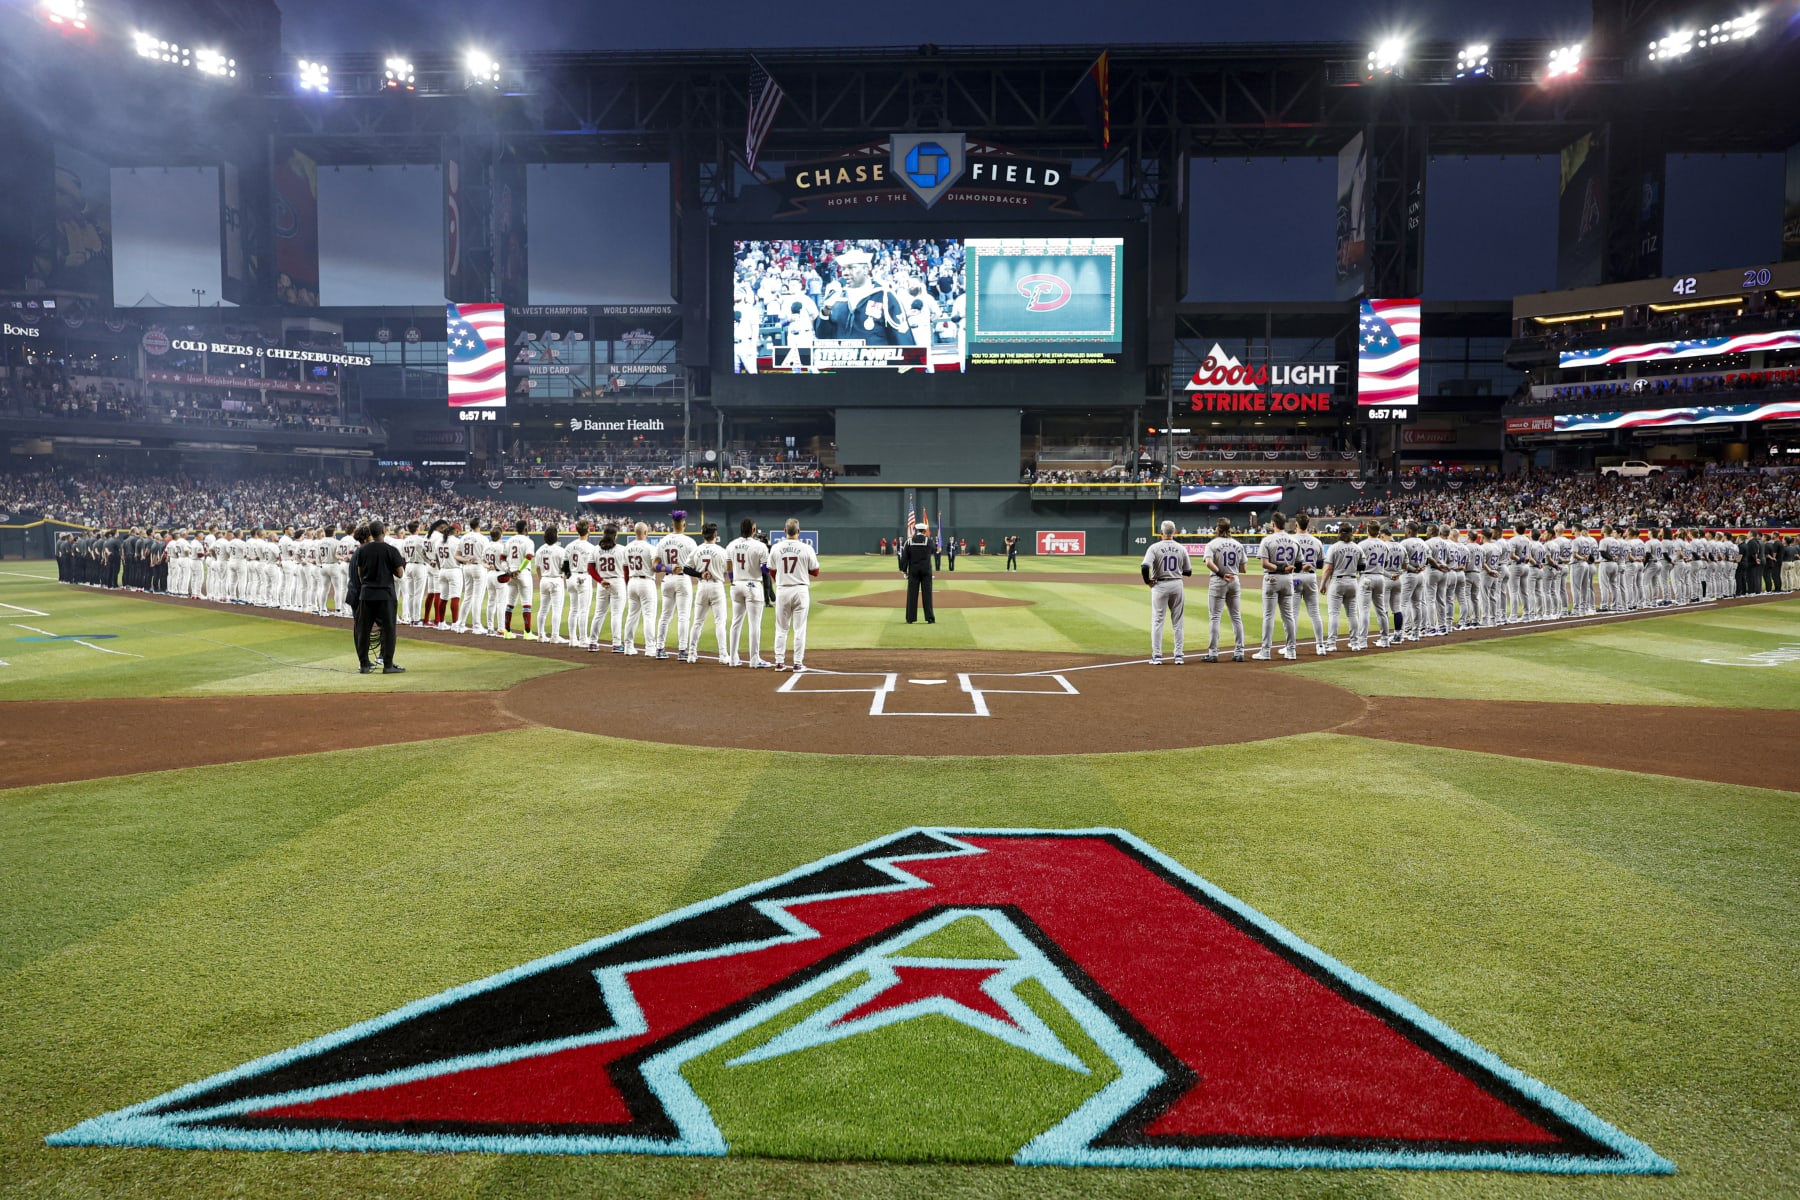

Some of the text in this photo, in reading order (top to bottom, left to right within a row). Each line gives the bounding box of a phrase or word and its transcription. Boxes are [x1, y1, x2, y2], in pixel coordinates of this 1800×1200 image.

[795, 163, 1061, 189] CHASE FIELD
[828, 193, 1028, 206] HOME OF THE DIAMONDBACKS
[1742, 269, 1771, 287] 20
[1672, 278, 1697, 295] 42
[522, 306, 542, 315] WEST
[544, 306, 588, 315] CHAMPIONS
[603, 306, 672, 315] WORLD CHAMPIONS
[172, 339, 207, 351] COLD
[211, 342, 254, 356] BEERS
[256, 347, 264, 357] &
[267, 348, 371, 366] CHEESEBURGERS
[815, 349, 904, 360] STEVEN POWELL
[529, 365, 570, 375] WILD CARD
[610, 364, 667, 374] NL CHAMPIONS
[1191, 355, 1340, 385] Coors LIGHT
[1191, 392, 1331, 411] STRIKE ZONE
[459, 410, 497, 420] 6:57 PM
[1368, 409, 1408, 419] 6:57 PM
[583, 418, 664, 431] Banner Health
[404, 546, 415, 558] 47
[464, 543, 474, 556] 81
[512, 546, 518, 559] 2
[665, 549, 678, 564] 12
[1276, 546, 1294, 562] 23
[1411, 550, 1424, 563] 44
[1521, 545, 1527, 556] 4
[543, 557, 550, 571] 5
[573, 554, 579, 568] 9
[599, 557, 616, 572] 28
[628, 555, 643, 571] 53
[702, 558, 711, 572] 7
[737, 553, 746, 570] 4
[782, 556, 799, 574] 17
[1163, 555, 1177, 572] 10
[1223, 551, 1237, 567] 19
[1345, 555, 1353, 570] 7
[1369, 552, 1385, 566] 24
[1389, 555, 1400, 568] 14
[1474, 554, 1480, 566] 8
